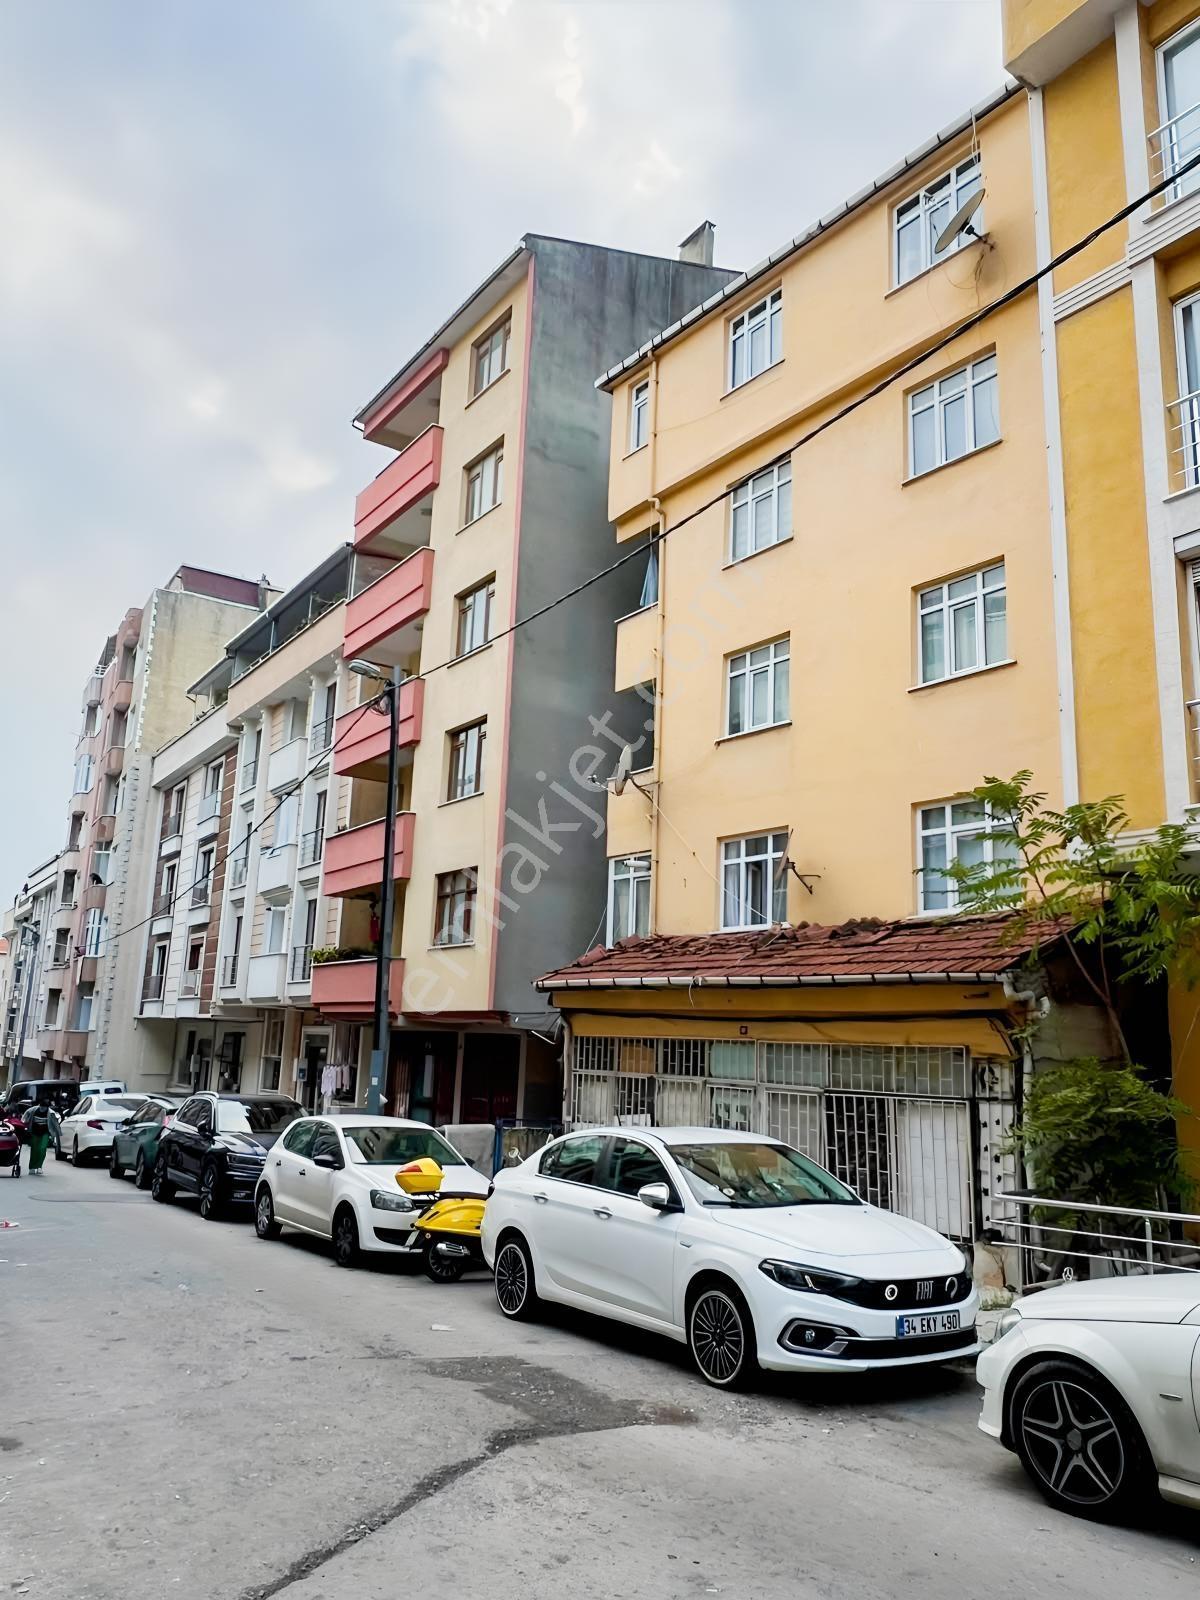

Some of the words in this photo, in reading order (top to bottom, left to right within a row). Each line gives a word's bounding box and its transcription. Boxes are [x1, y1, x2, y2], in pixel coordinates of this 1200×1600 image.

[916, 1280, 935, 1301] FIAT
[904, 1318, 917, 1335] 34
[921, 1316, 937, 1333] EKY
[941, 1314, 958, 1331] 490
